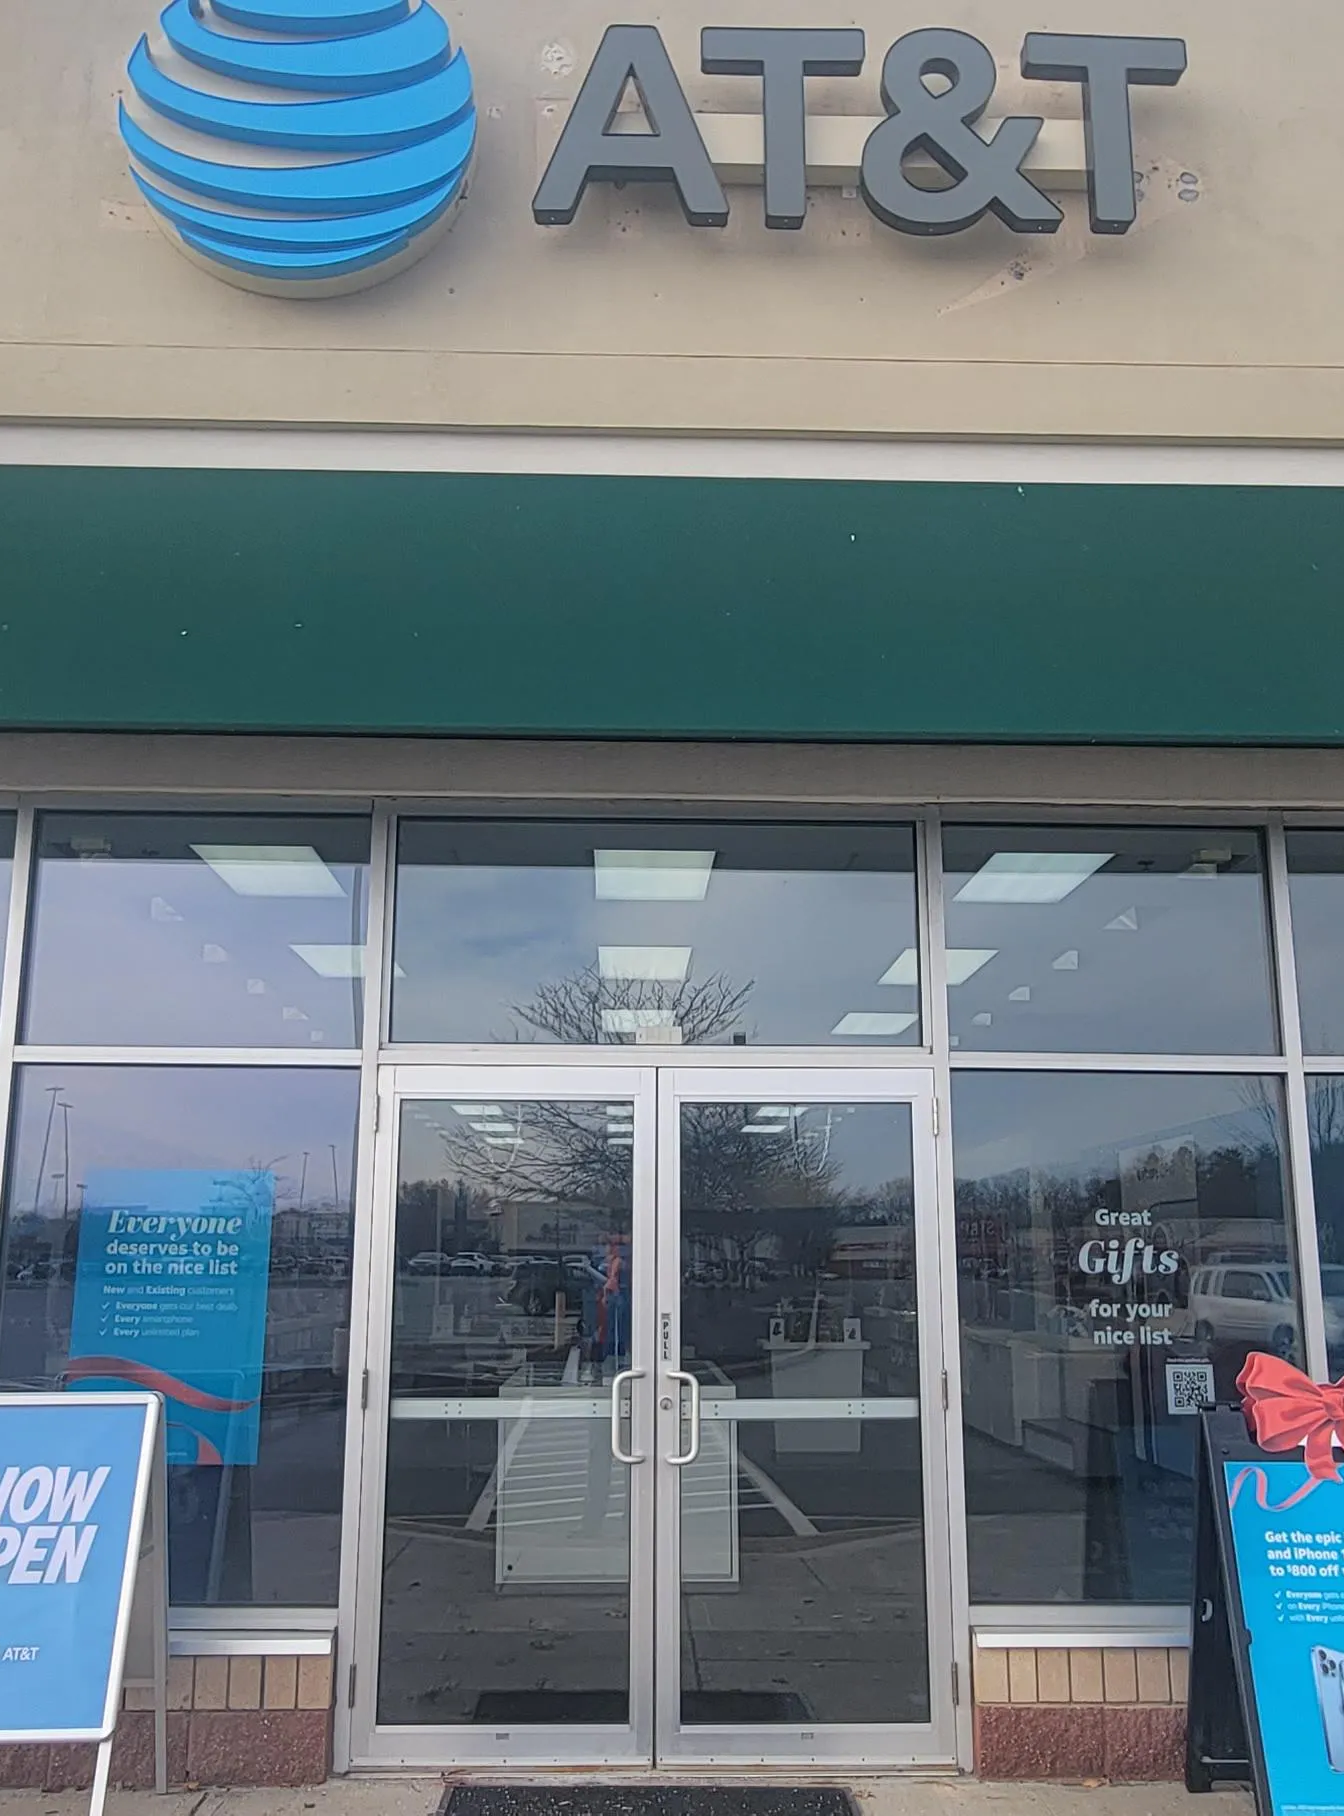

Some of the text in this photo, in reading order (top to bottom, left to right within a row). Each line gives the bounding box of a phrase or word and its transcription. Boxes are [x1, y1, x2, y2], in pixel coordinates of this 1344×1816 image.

[532, 23, 1187, 236] AT&T
[1095, 1209, 1152, 1226] Great
[107, 1209, 243, 1241] Everyone
[107, 1240, 239, 1256] deserves to be
[105, 1259, 238, 1275] on the nice list
[1079, 1237, 1179, 1285] Gifts
[103, 1285, 126, 1295] New
[127, 1286, 144, 1294] and
[146, 1285, 186, 1296] Existing
[116, 1302, 157, 1312] Everyone
[1090, 1299, 1173, 1323] for your
[114, 1314, 141, 1324] Every
[113, 1327, 140, 1338] Every
[1094, 1327, 1173, 1345] nice list
[1264, 1531, 1288, 1544] Get
[1290, 1531, 1313, 1544] the
[1315, 1532, 1343, 1546] epic
[1267, 1548, 1291, 1560] and
[1294, 1548, 1338, 1560] iPhone
[1269, 1565, 1285, 1577] to
[1286, 1565, 1317, 1577] $800
[1319, 1564, 1339, 1577] off
[1298, 1602, 1321, 1612] Every
[1306, 1614, 1329, 1624] Every
[2, 1647, 40, 1661] AT&T
